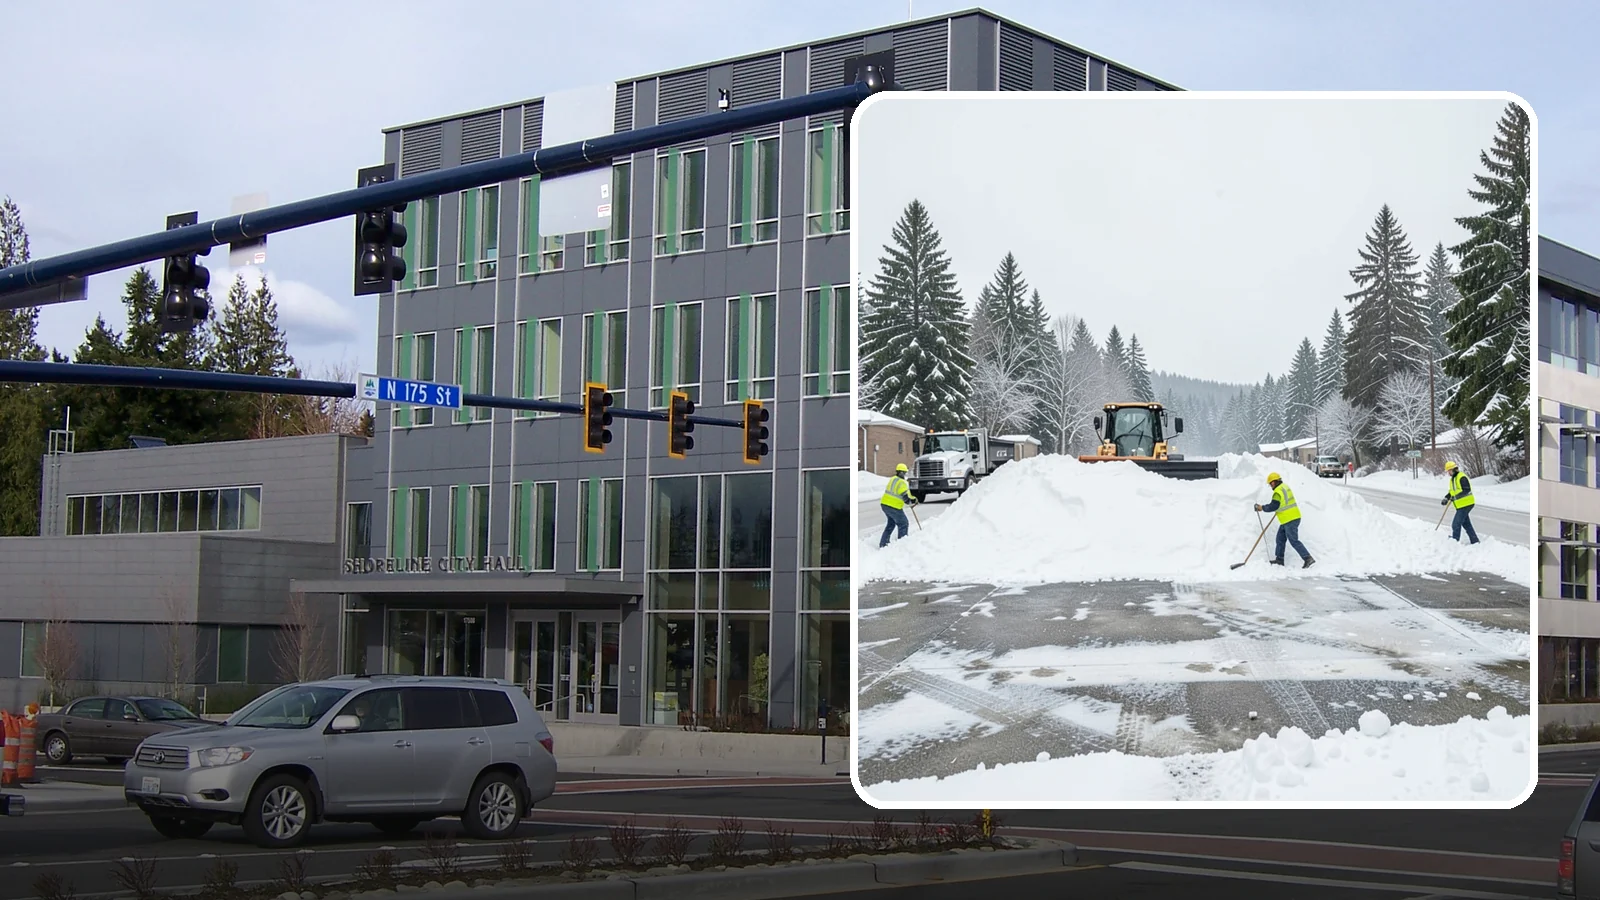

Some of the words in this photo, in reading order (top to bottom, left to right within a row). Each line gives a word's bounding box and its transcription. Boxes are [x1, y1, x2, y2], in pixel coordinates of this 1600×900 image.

[387, 380, 396, 400] N
[405, 382, 427, 403] 175
[436, 386, 451, 406] St
[345, 556, 432, 574] SHORELINE
[438, 556, 477, 573] CITY
[483, 555, 525, 572] HALL
